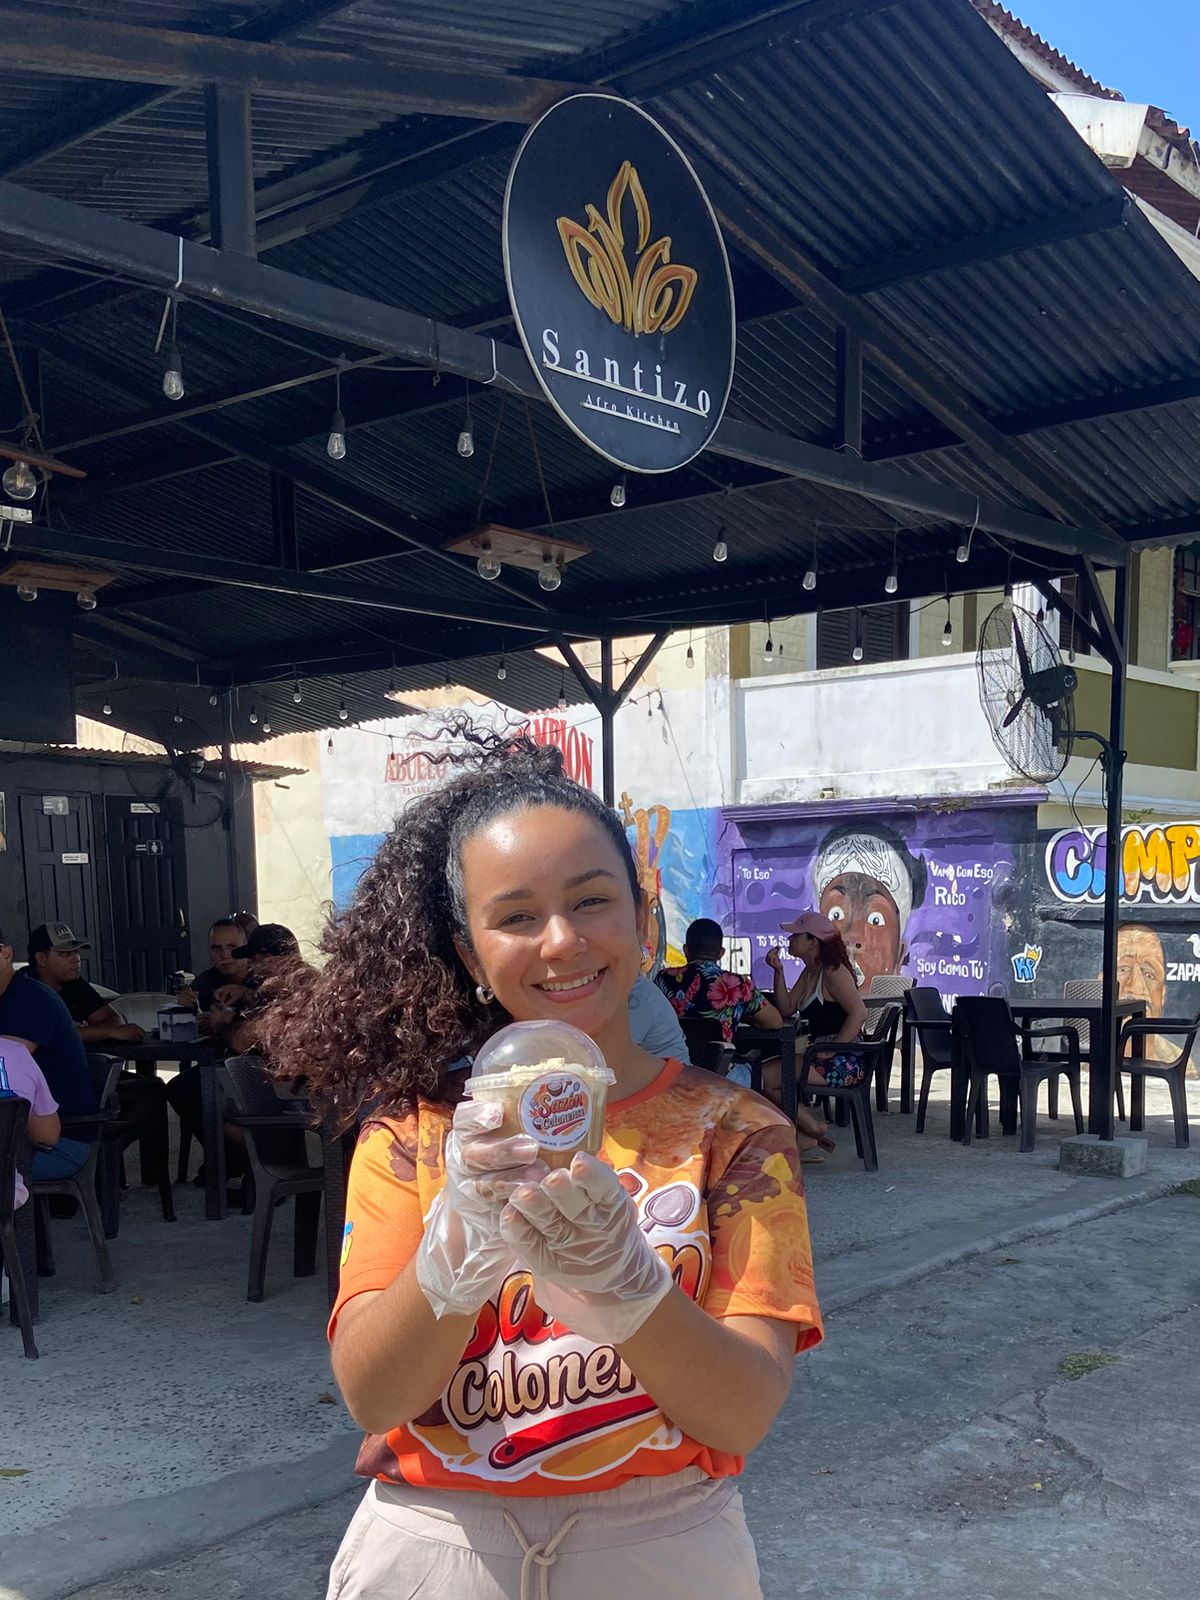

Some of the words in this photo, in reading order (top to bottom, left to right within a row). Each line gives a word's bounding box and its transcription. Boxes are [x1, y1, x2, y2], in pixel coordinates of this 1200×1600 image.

[542, 328, 711, 415] Santizo
[586, 394, 616, 412] Afro
[626, 405, 679, 430] Kitchen
[1166, 962, 1200, 982] ZAPA
